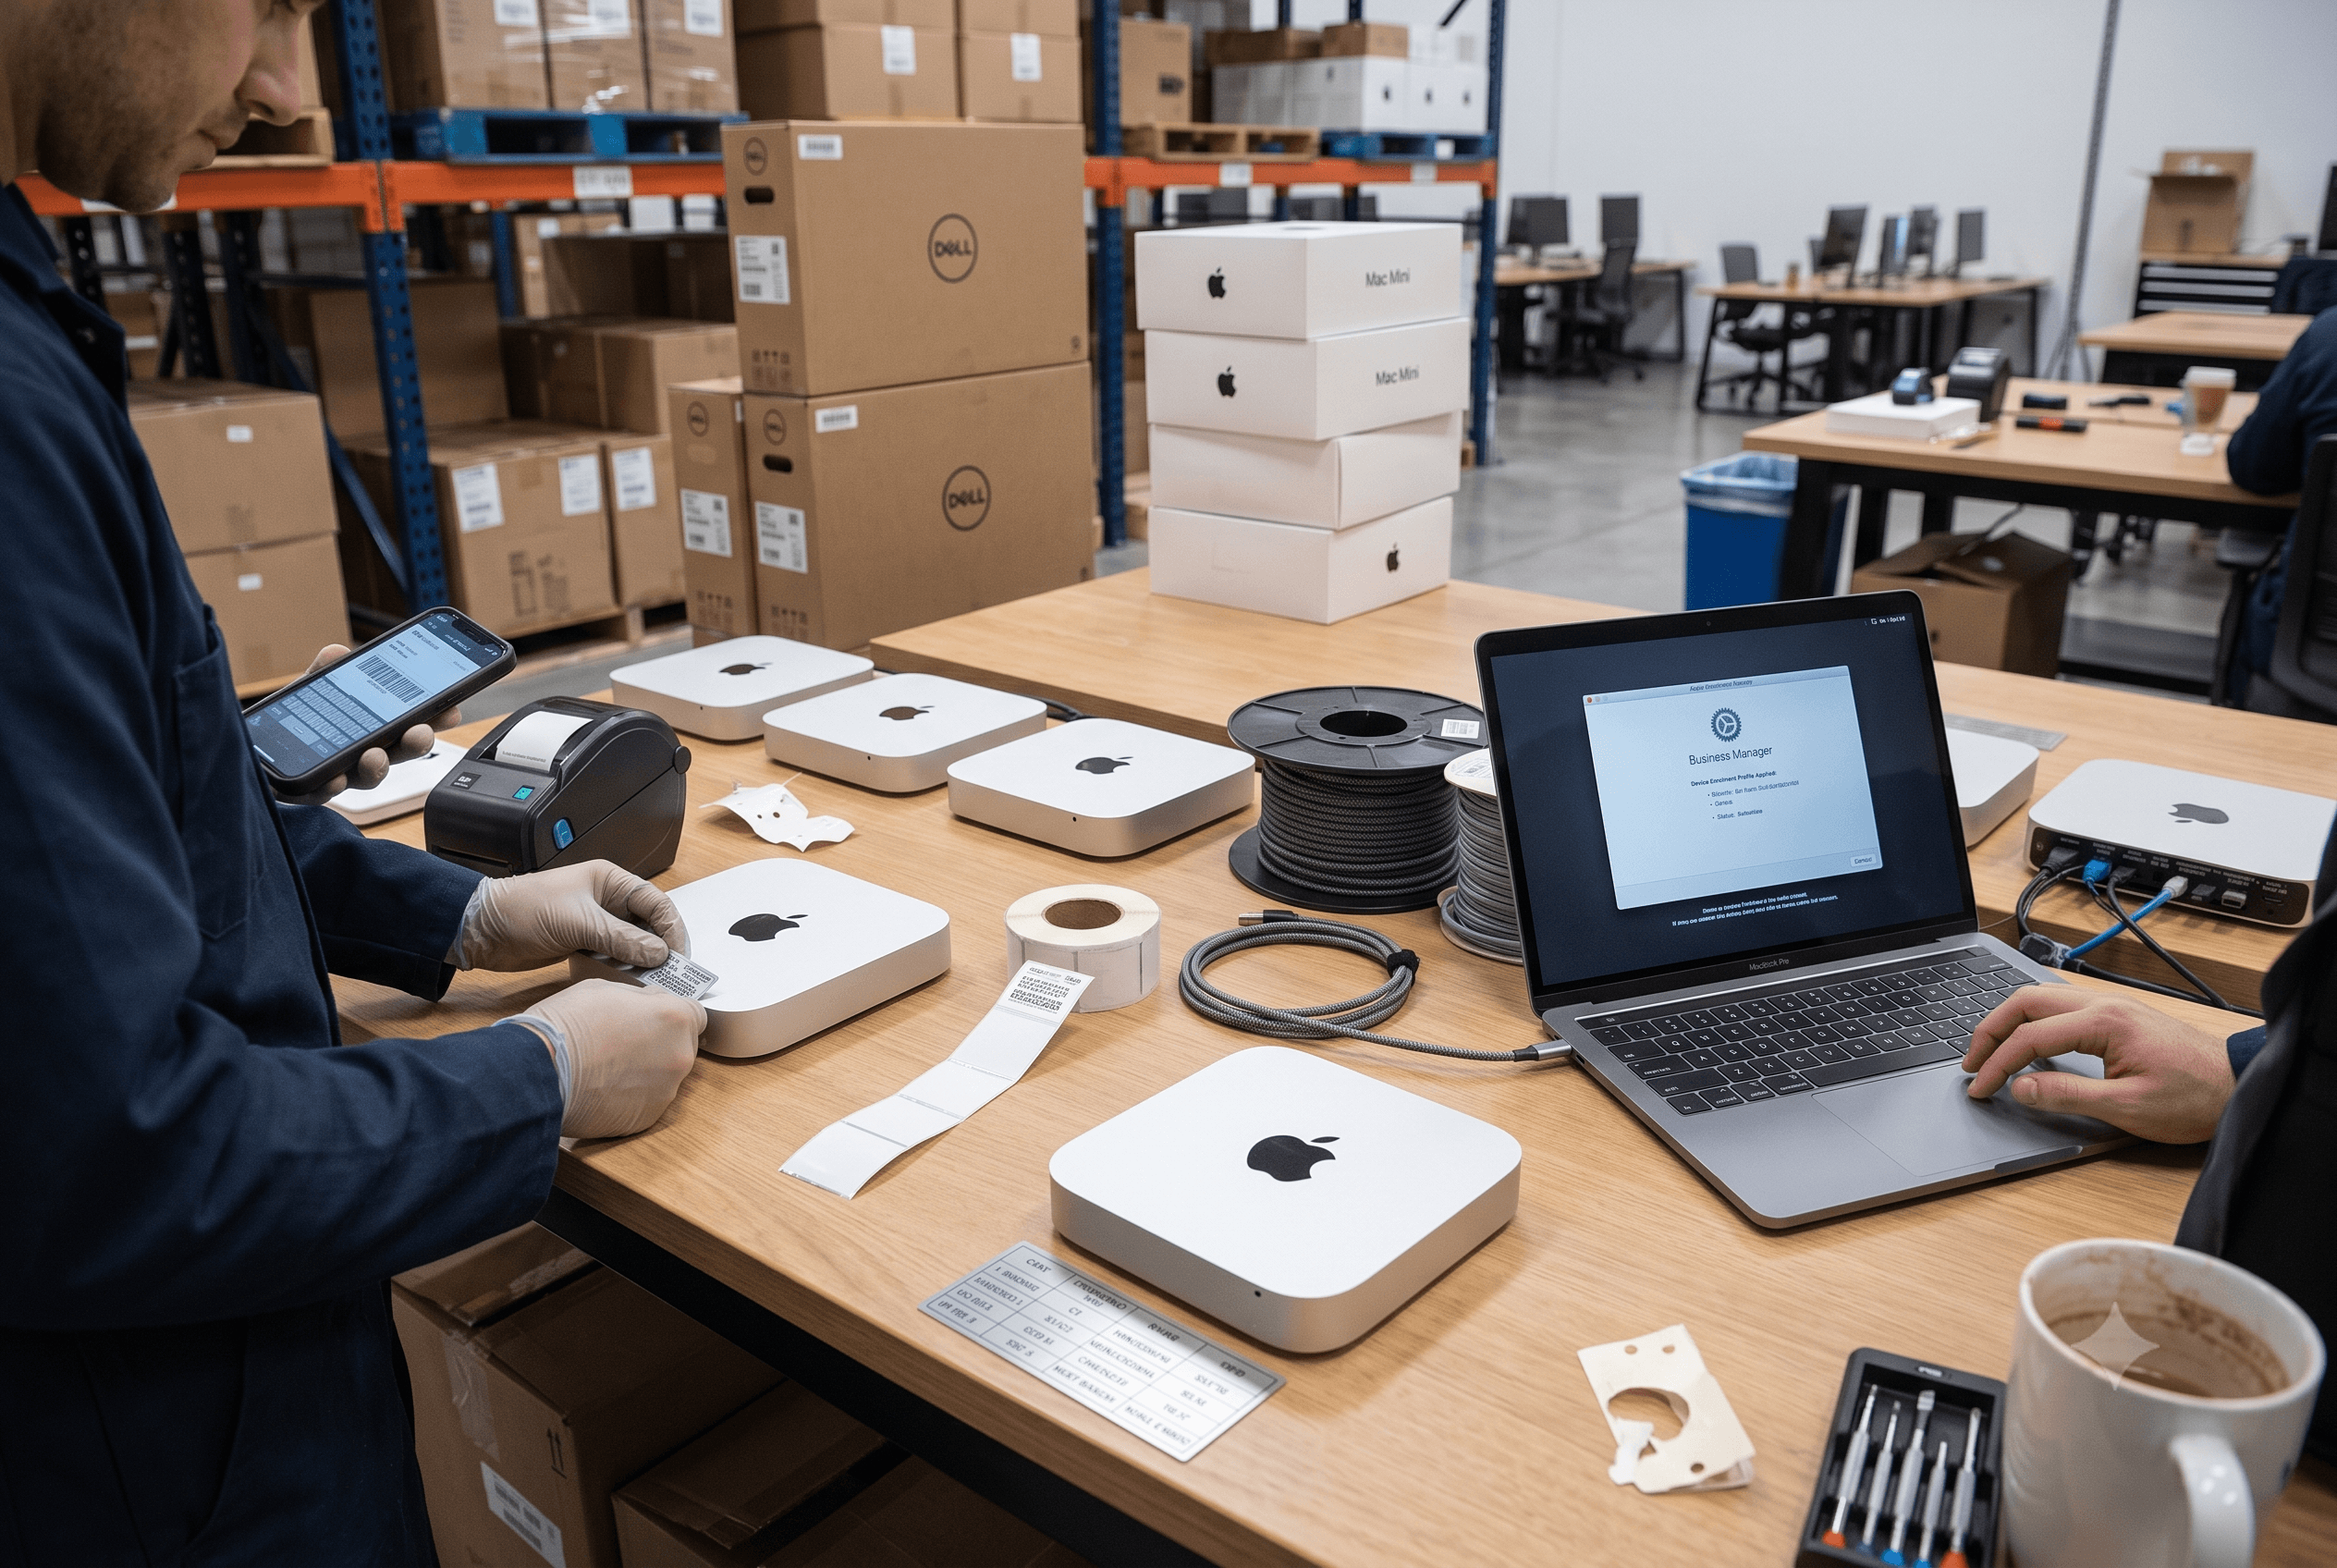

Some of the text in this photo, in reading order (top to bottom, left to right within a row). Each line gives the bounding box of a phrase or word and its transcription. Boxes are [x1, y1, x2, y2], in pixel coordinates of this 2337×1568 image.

[1365, 267, 1411, 288] Mac Mini
[1376, 365, 1420, 386] Mac Mini
[1689, 747, 1773, 766] Business Manager
